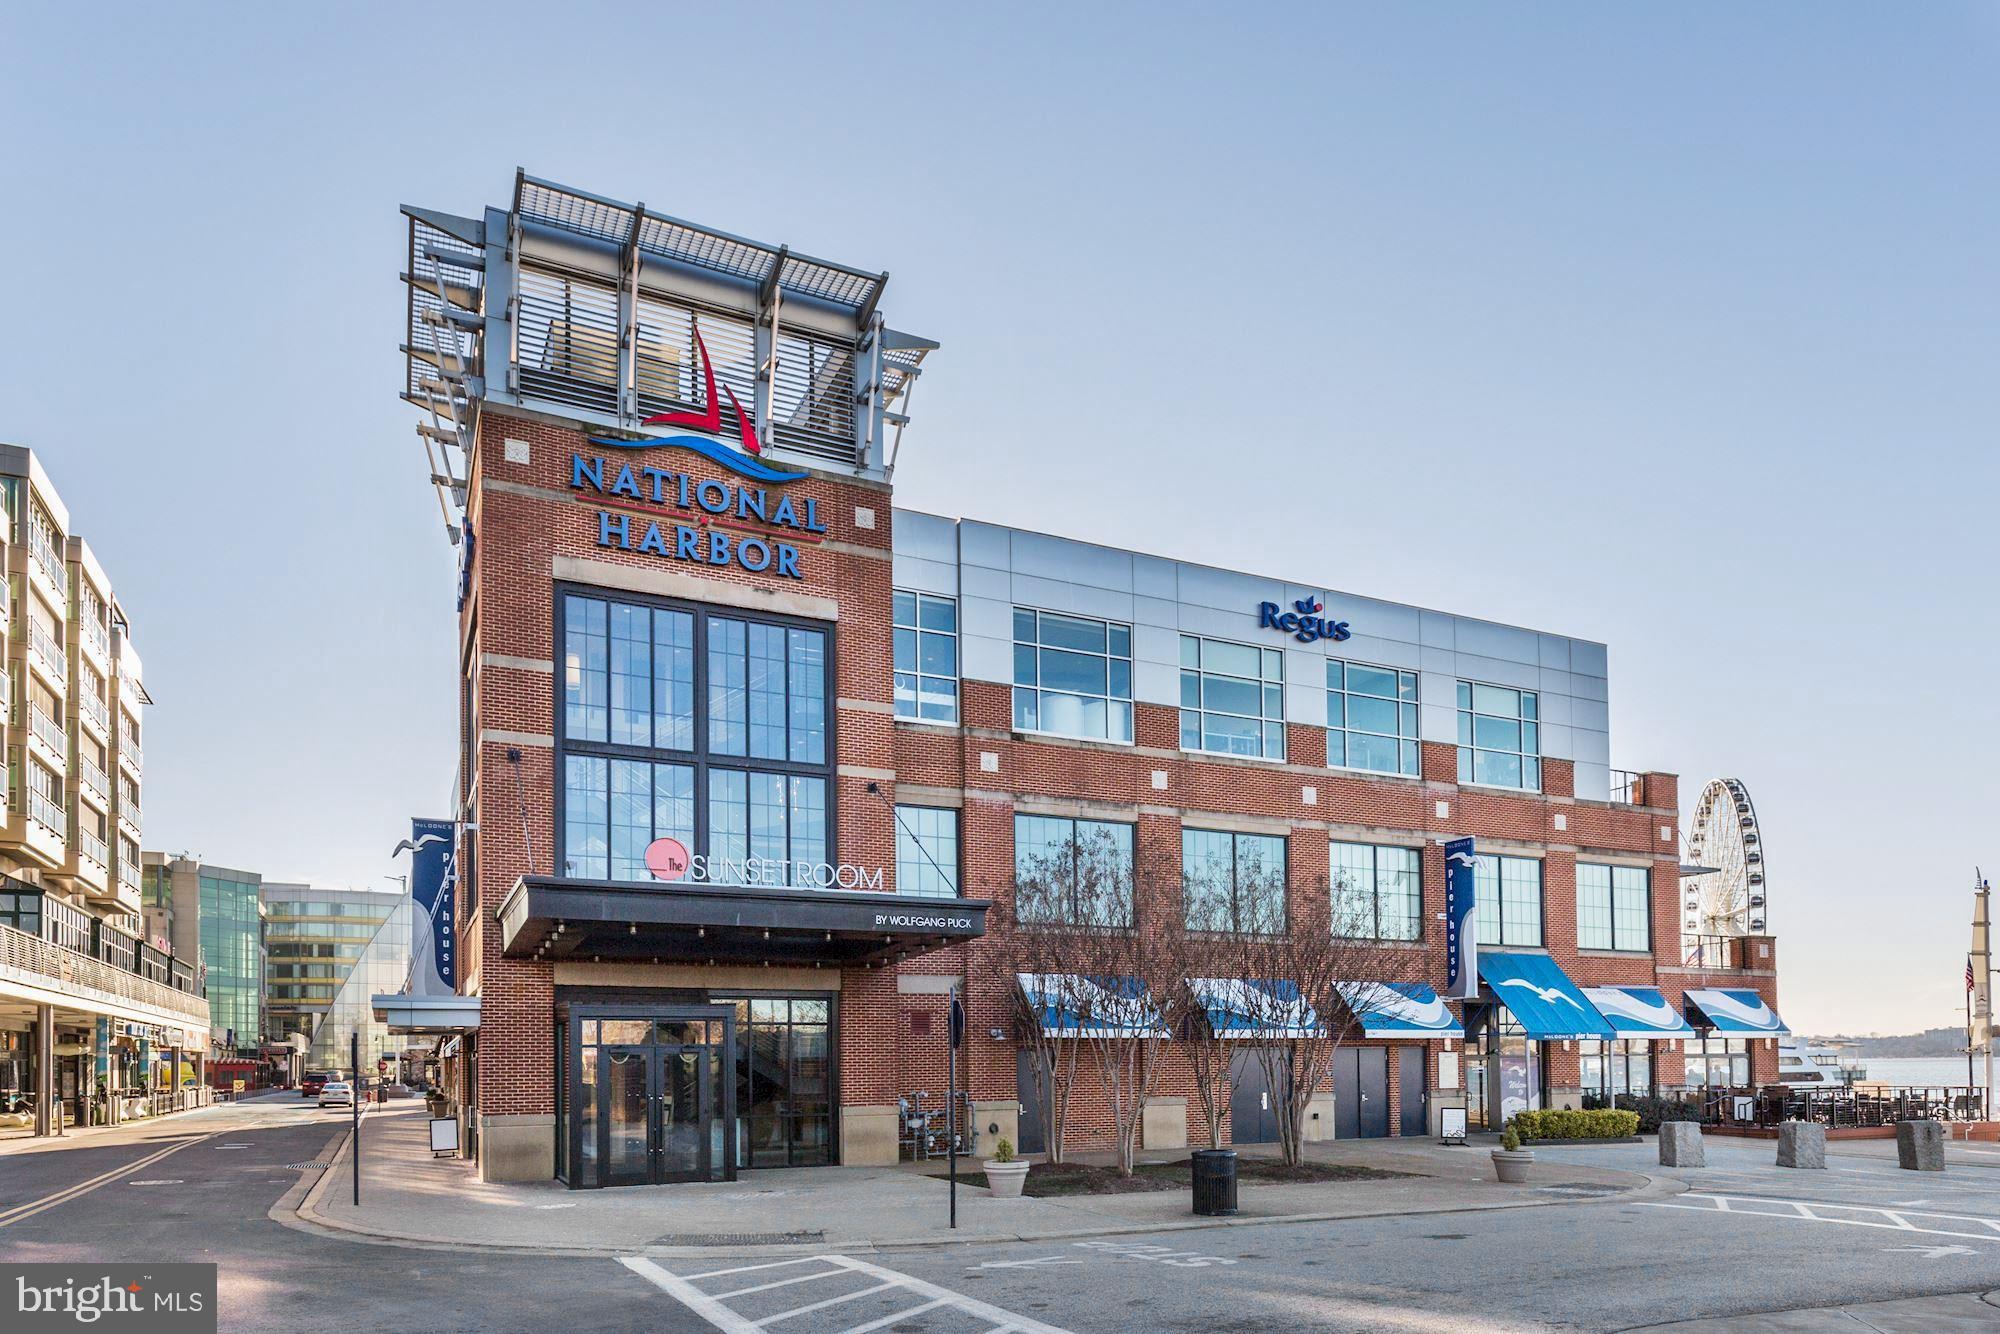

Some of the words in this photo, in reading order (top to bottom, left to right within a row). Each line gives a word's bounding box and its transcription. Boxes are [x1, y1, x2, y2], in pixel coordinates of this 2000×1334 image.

[570, 453, 827, 533] NATIONAL
[597, 511, 803, 578] HARBOR
[1259, 601, 1351, 643] Regus
[668, 857, 683, 872] The
[691, 855, 790, 884] SUNSET
[797, 860, 883, 890] ROOM
[442, 911, 450, 975] house
[875, 915, 887, 925] BY
[889, 915, 946, 928] WOLFGANG
[947, 918, 972, 929] PUCK
